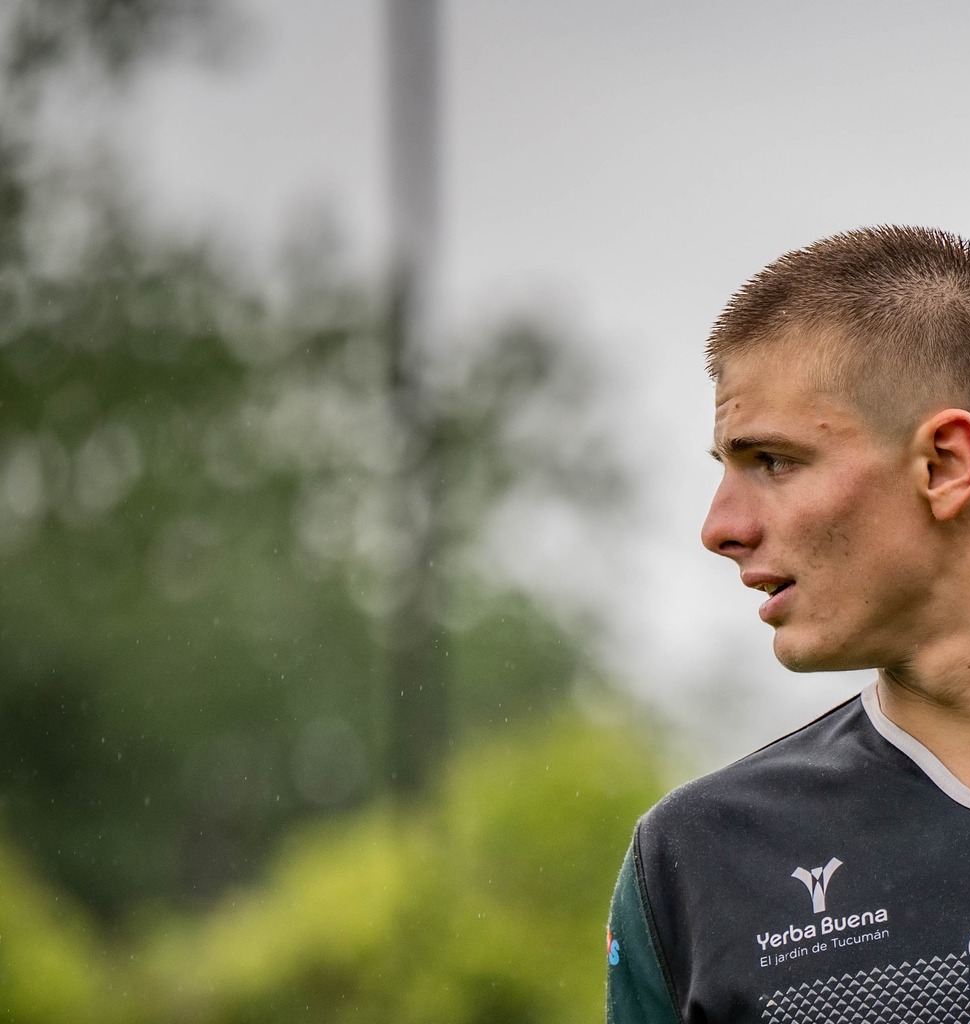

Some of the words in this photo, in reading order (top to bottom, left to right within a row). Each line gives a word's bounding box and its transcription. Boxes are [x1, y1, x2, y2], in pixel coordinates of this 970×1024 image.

[756, 924, 816, 950] Yerba
[821, 908, 888, 935] Buena
[760, 954, 771, 967] El
[775, 946, 808, 965] jardín
[812, 942, 827, 953] de
[831, 929, 889, 948] Tucumán
